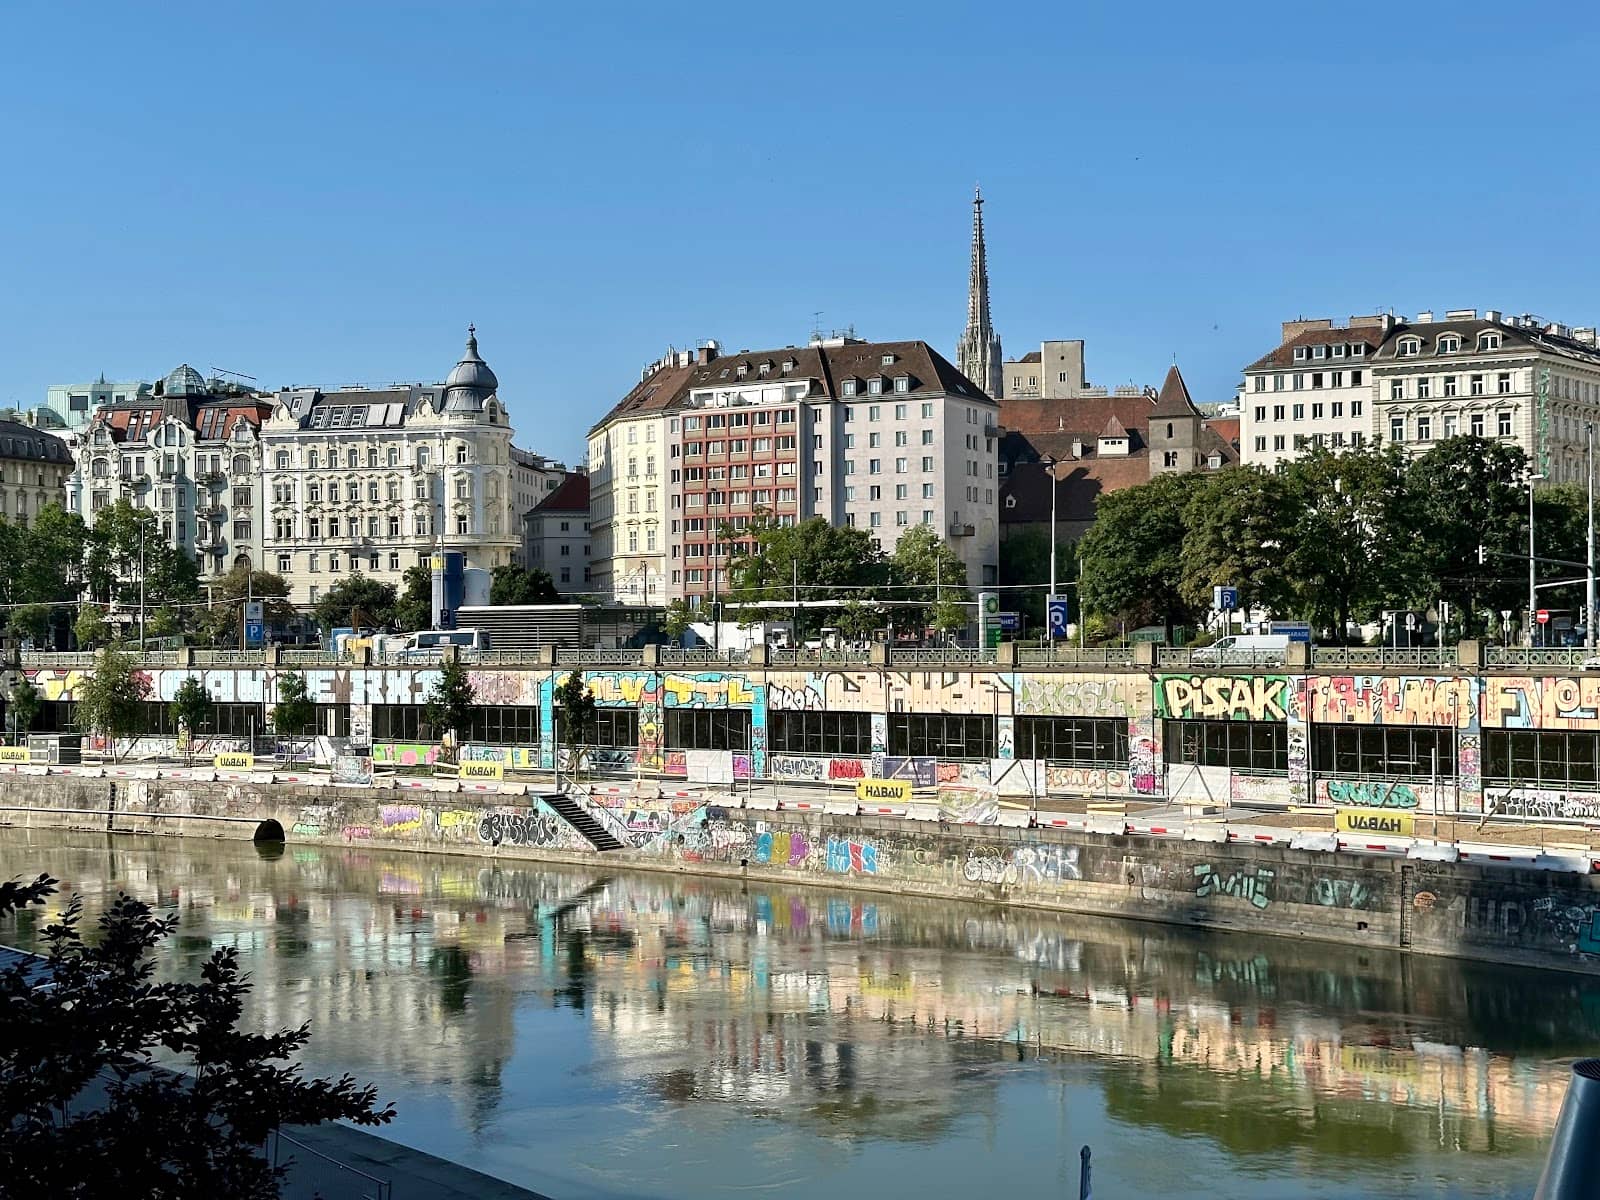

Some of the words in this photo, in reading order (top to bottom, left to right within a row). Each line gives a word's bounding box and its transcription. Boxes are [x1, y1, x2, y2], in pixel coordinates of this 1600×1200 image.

[1224, 595, 1231, 606] P
[1051, 612, 1063, 633] P
[250, 626, 258, 637] P
[866, 785, 904, 799] HABAU
